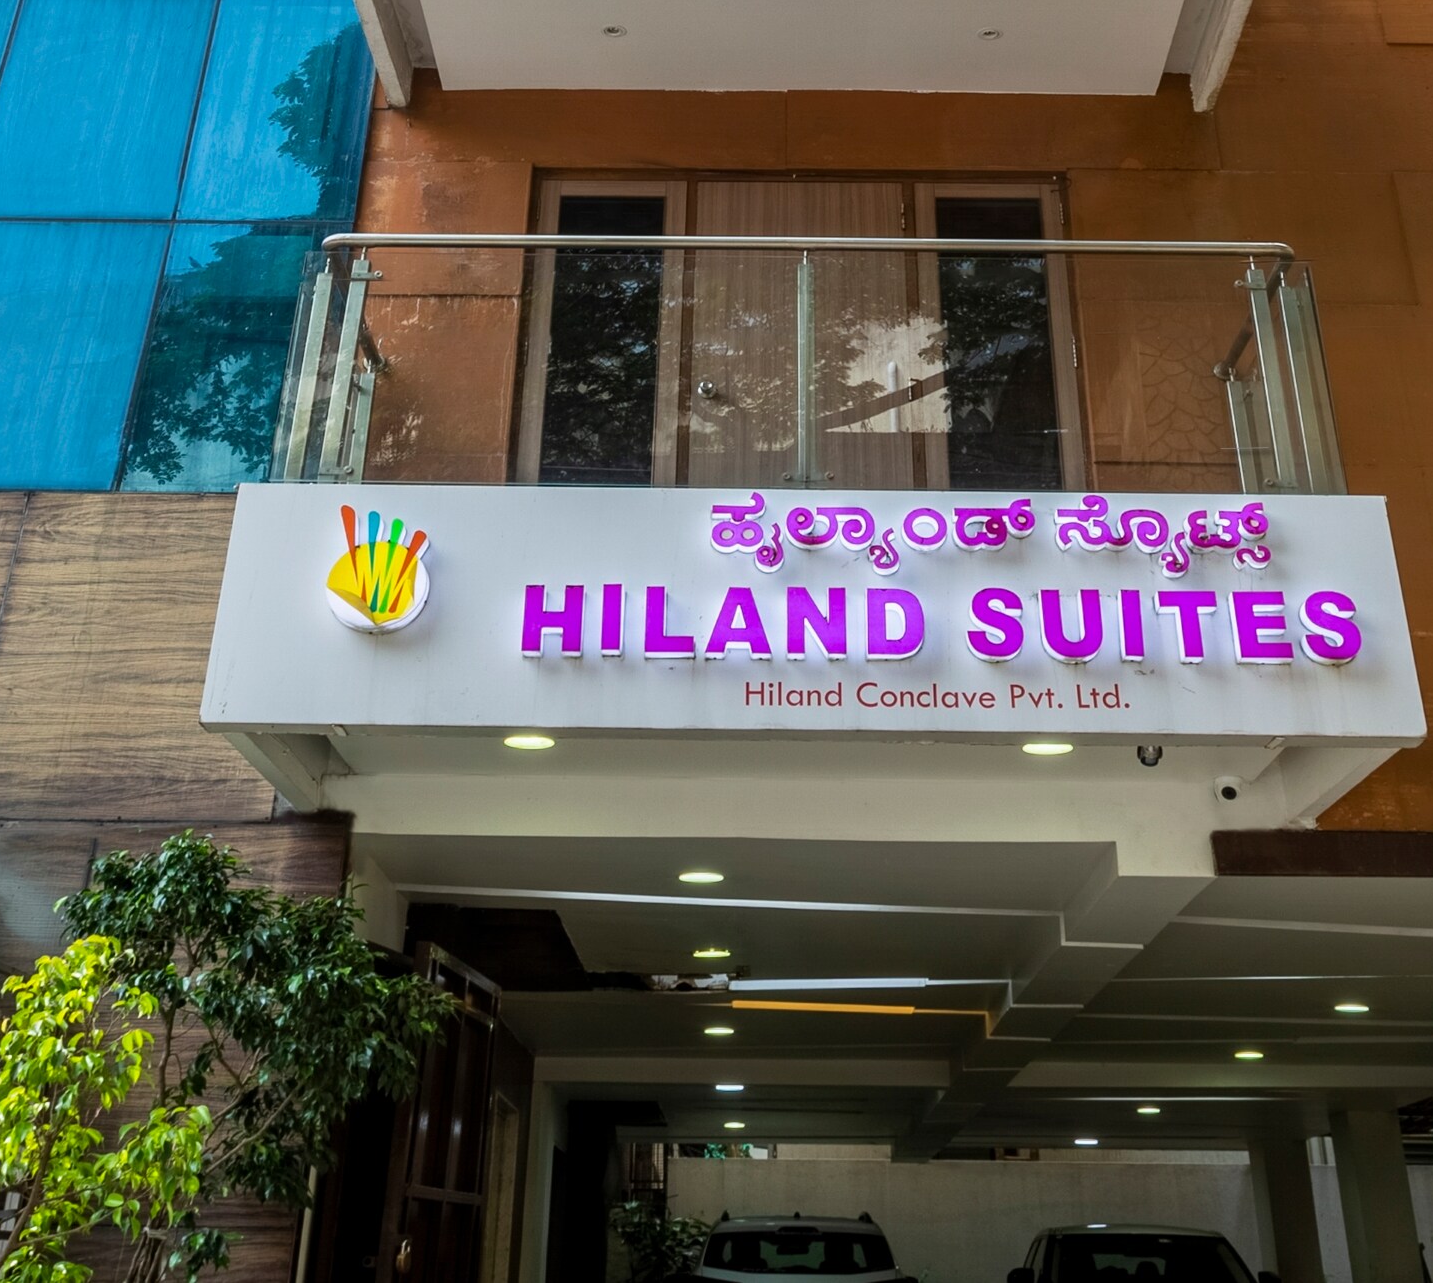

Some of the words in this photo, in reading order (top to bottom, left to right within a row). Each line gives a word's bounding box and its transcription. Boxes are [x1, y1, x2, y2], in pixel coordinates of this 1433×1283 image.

[522, 584, 925, 661] HILAND
[967, 587, 1362, 665] SUITES
[745, 682, 842, 707] Hiland
[856, 682, 996, 710] Conclave
[1010, 684, 1063, 709] Pvt.
[1077, 684, 1131, 709] Ltd.
